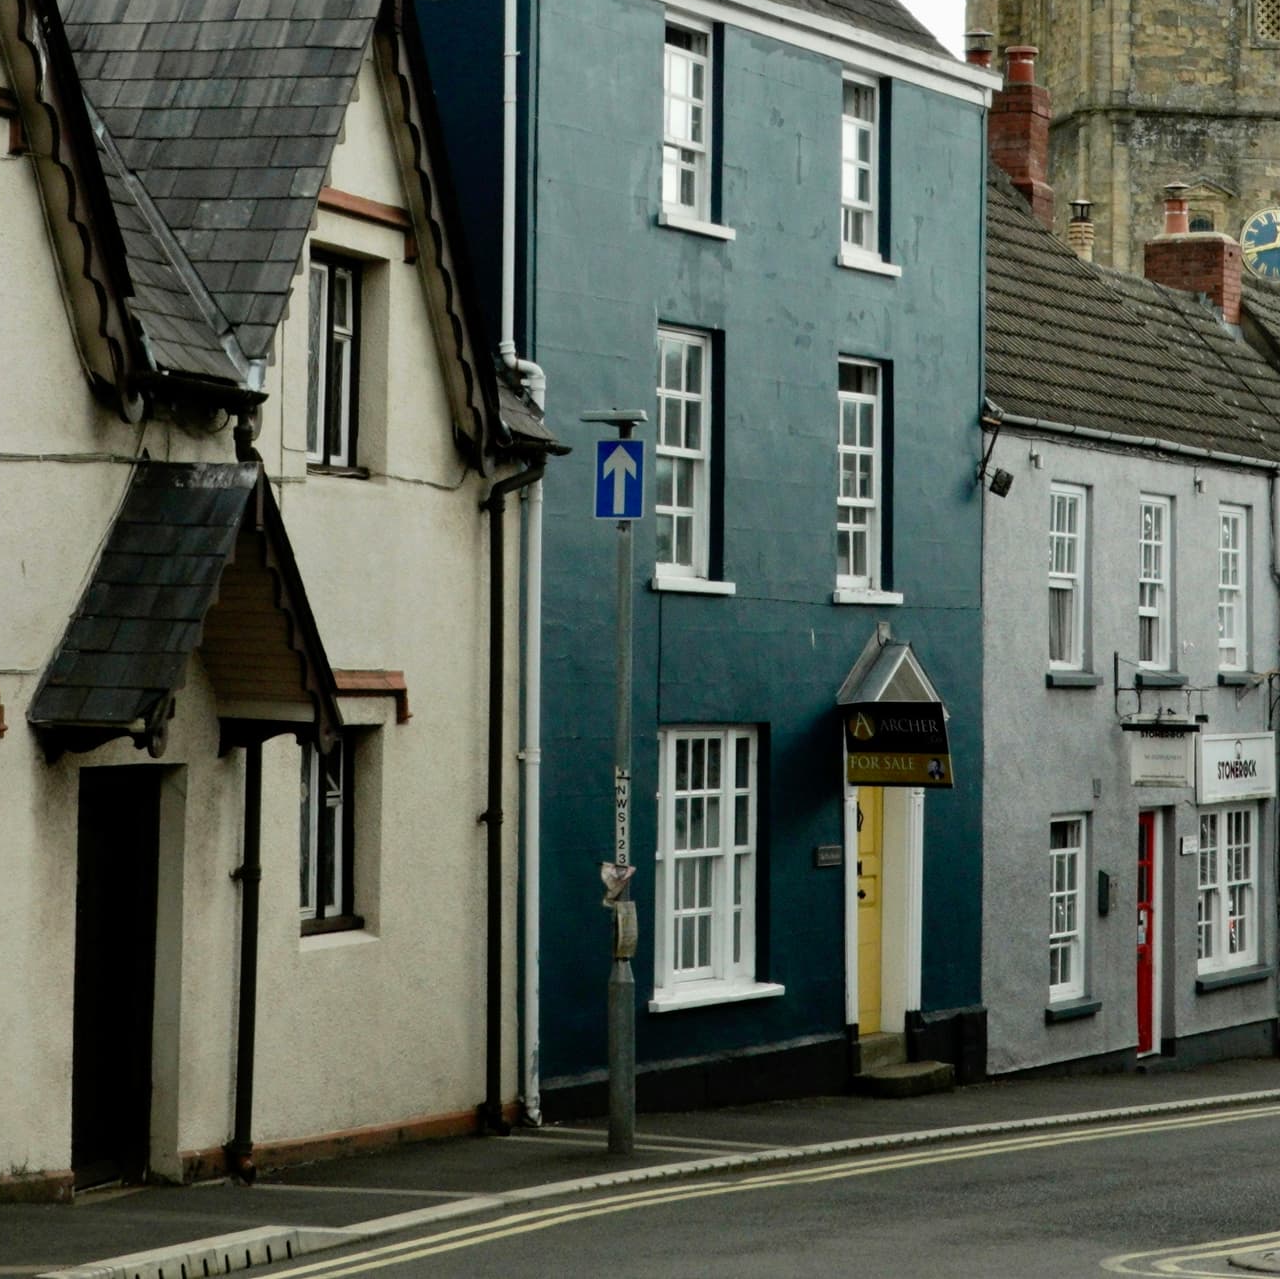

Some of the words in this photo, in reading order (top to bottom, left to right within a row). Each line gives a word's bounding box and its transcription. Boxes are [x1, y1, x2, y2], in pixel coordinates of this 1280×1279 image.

[853, 712, 874, 737] A
[880, 719, 938, 733] ARCHER
[850, 756, 880, 769] FOR
[883, 757, 914, 770] SALE
[1217, 759, 1257, 781] STONEROCK
